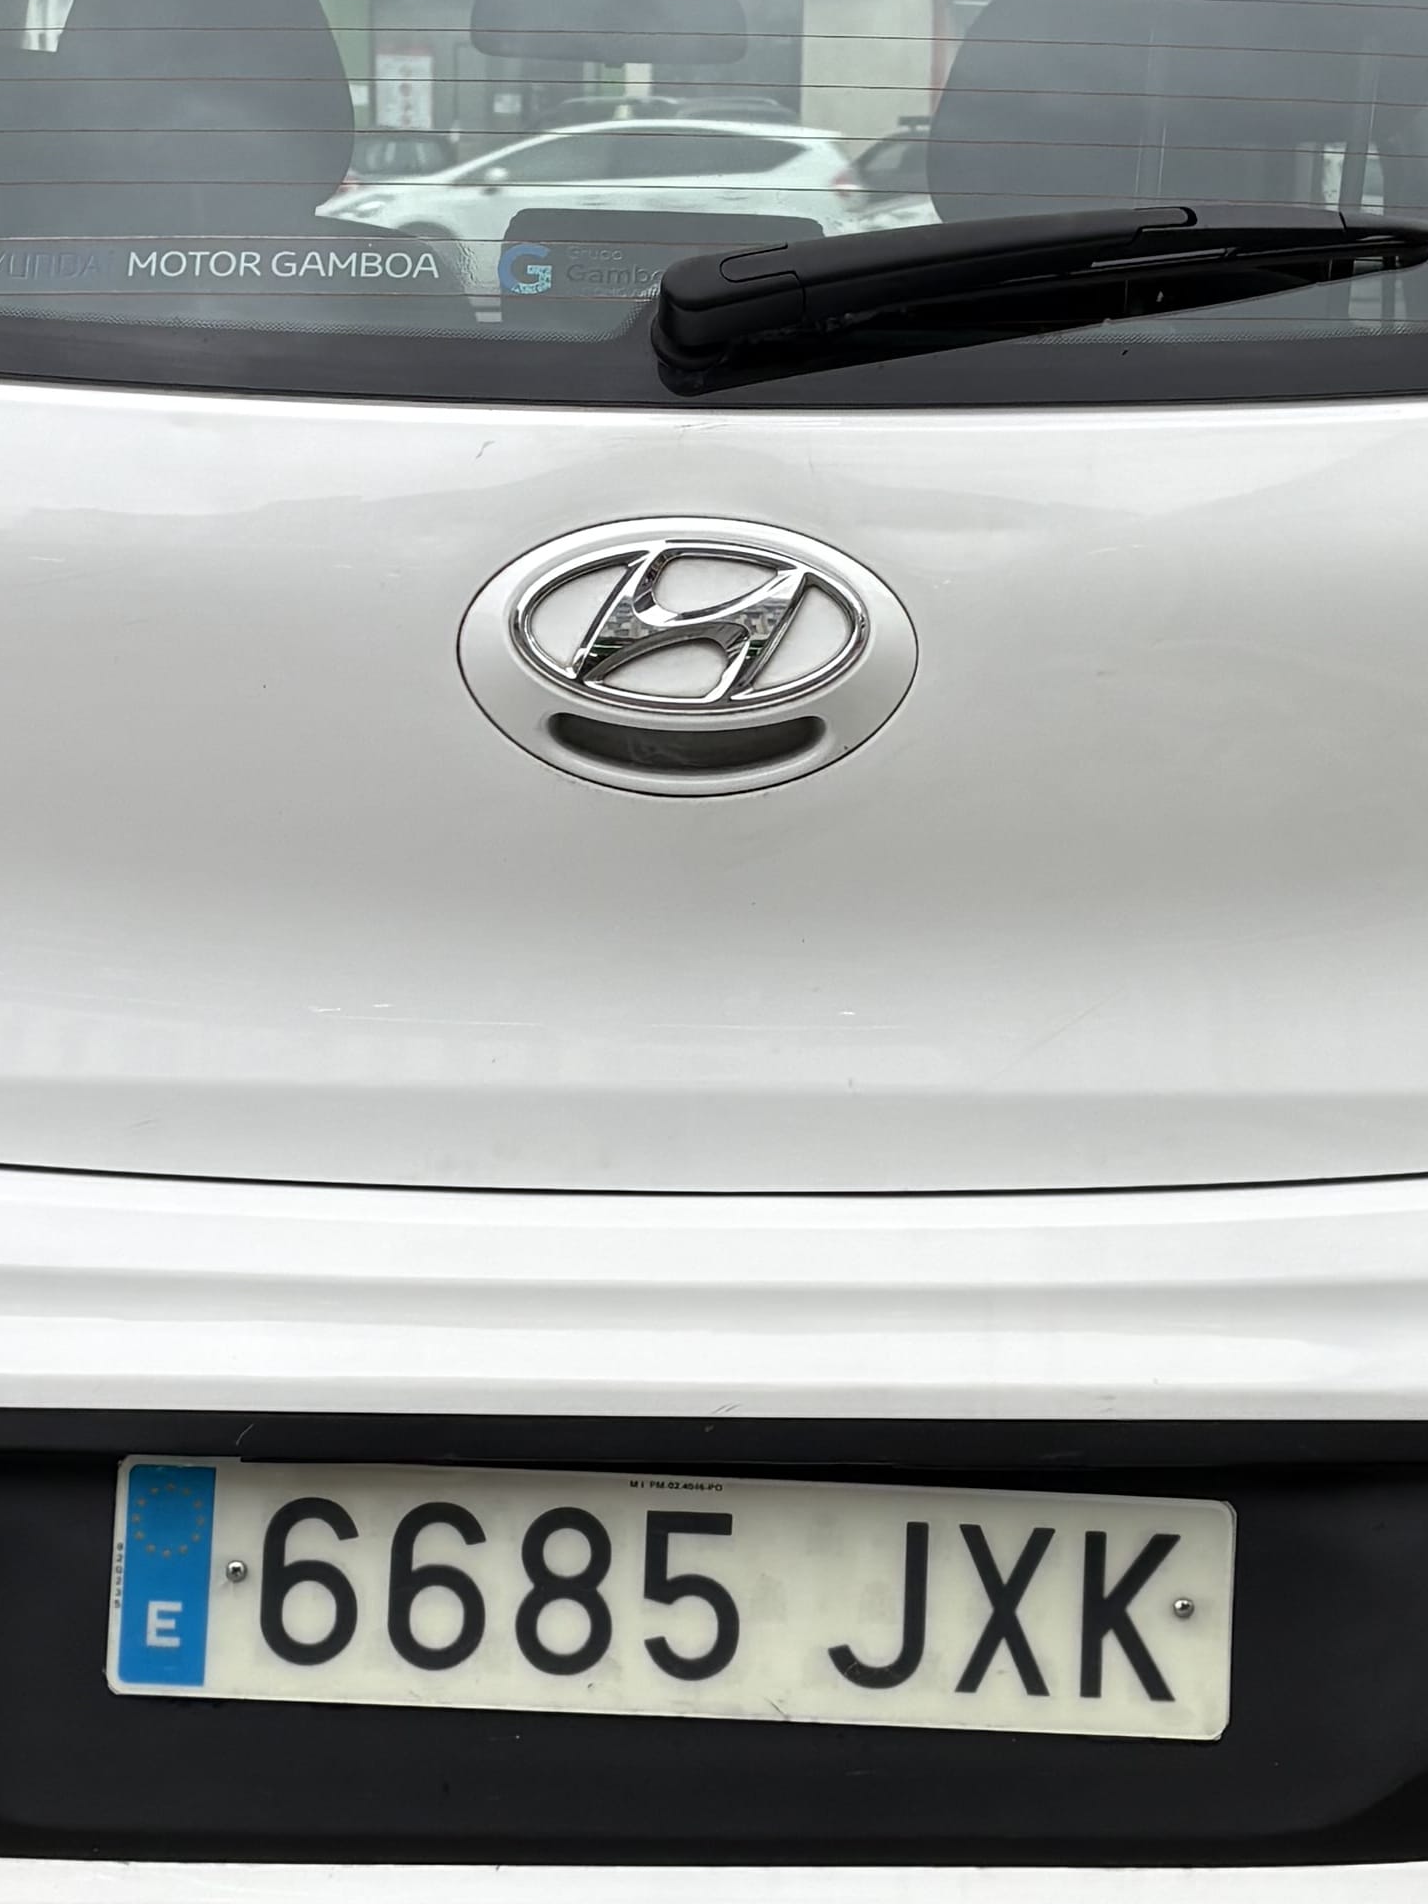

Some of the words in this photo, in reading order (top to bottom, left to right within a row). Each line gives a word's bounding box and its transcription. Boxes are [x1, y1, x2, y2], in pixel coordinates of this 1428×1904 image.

[127, 250, 262, 278] MOTOR
[271, 251, 440, 279] GAMBOA
[567, 263, 664, 285] Gambo
[258, 1496, 741, 1682] 6685
[826, 1519, 1181, 1703] JXK
[145, 1600, 183, 1648] E
